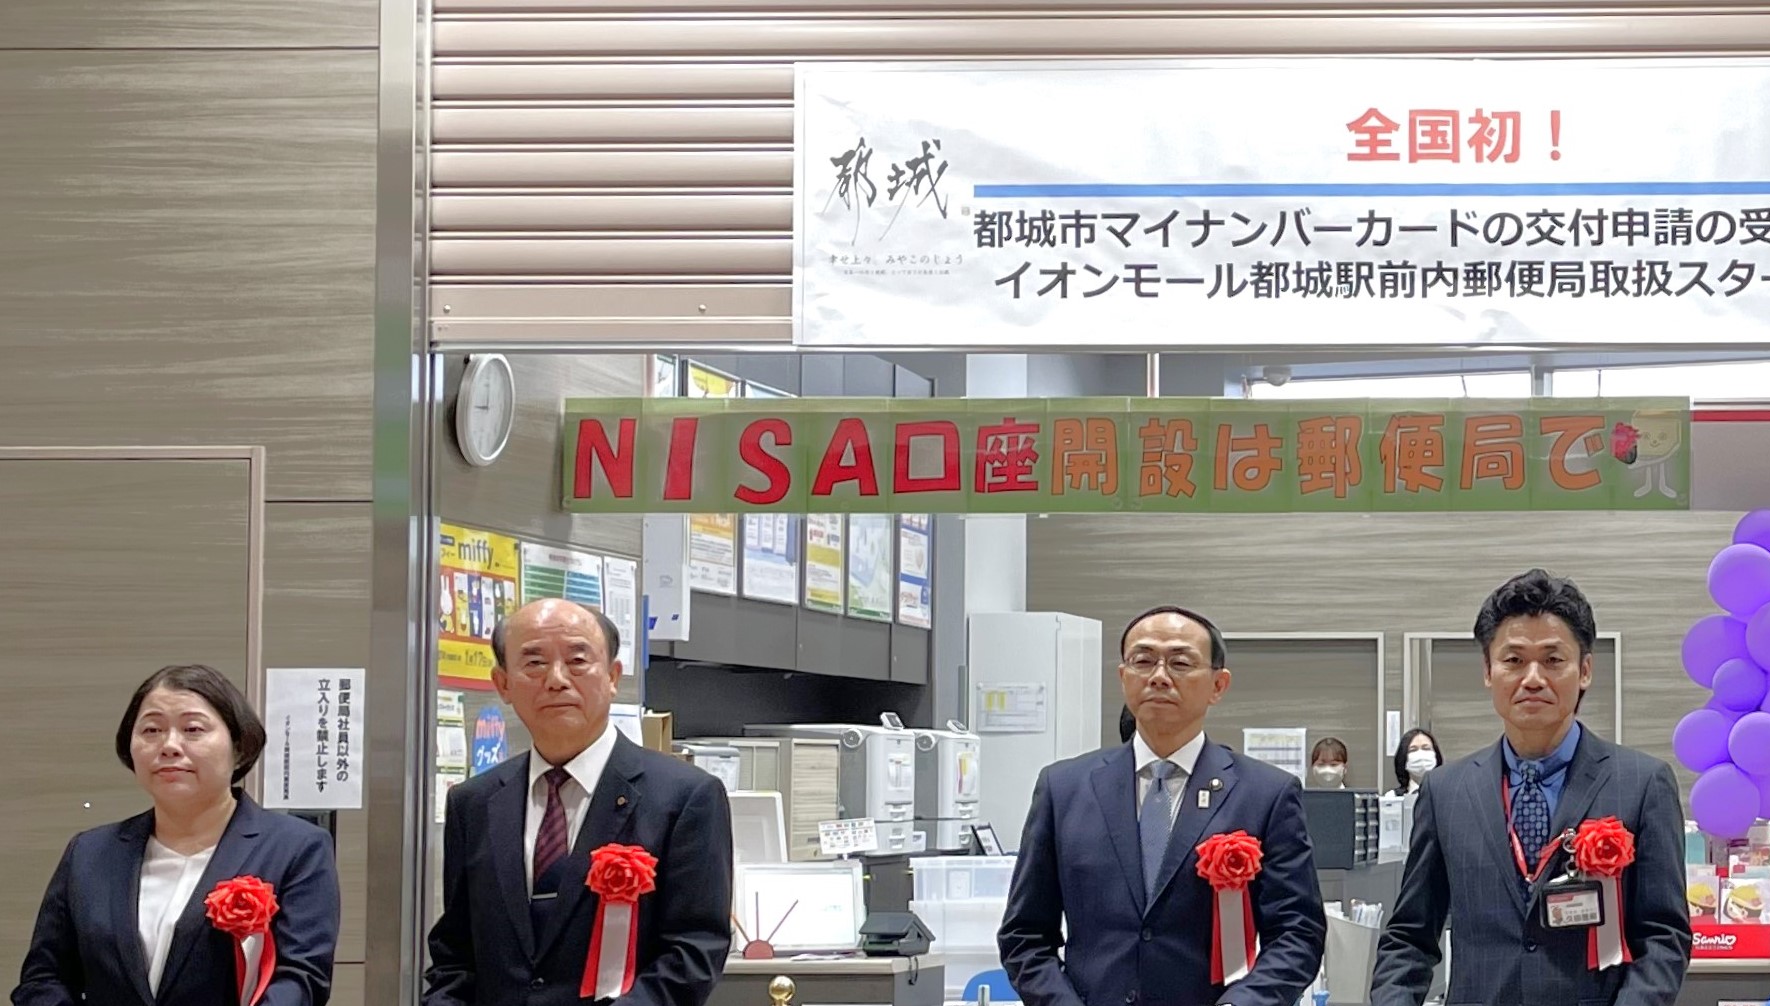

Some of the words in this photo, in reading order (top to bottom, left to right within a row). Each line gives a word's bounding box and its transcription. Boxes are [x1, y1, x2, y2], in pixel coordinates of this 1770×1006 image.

[1345, 107, 1562, 164] 全国初！
[457, 538, 494, 569] miffy
[316, 678, 331, 793] 立入りを禁止します
[336, 678, 351, 782] 郵便局社員以外の
